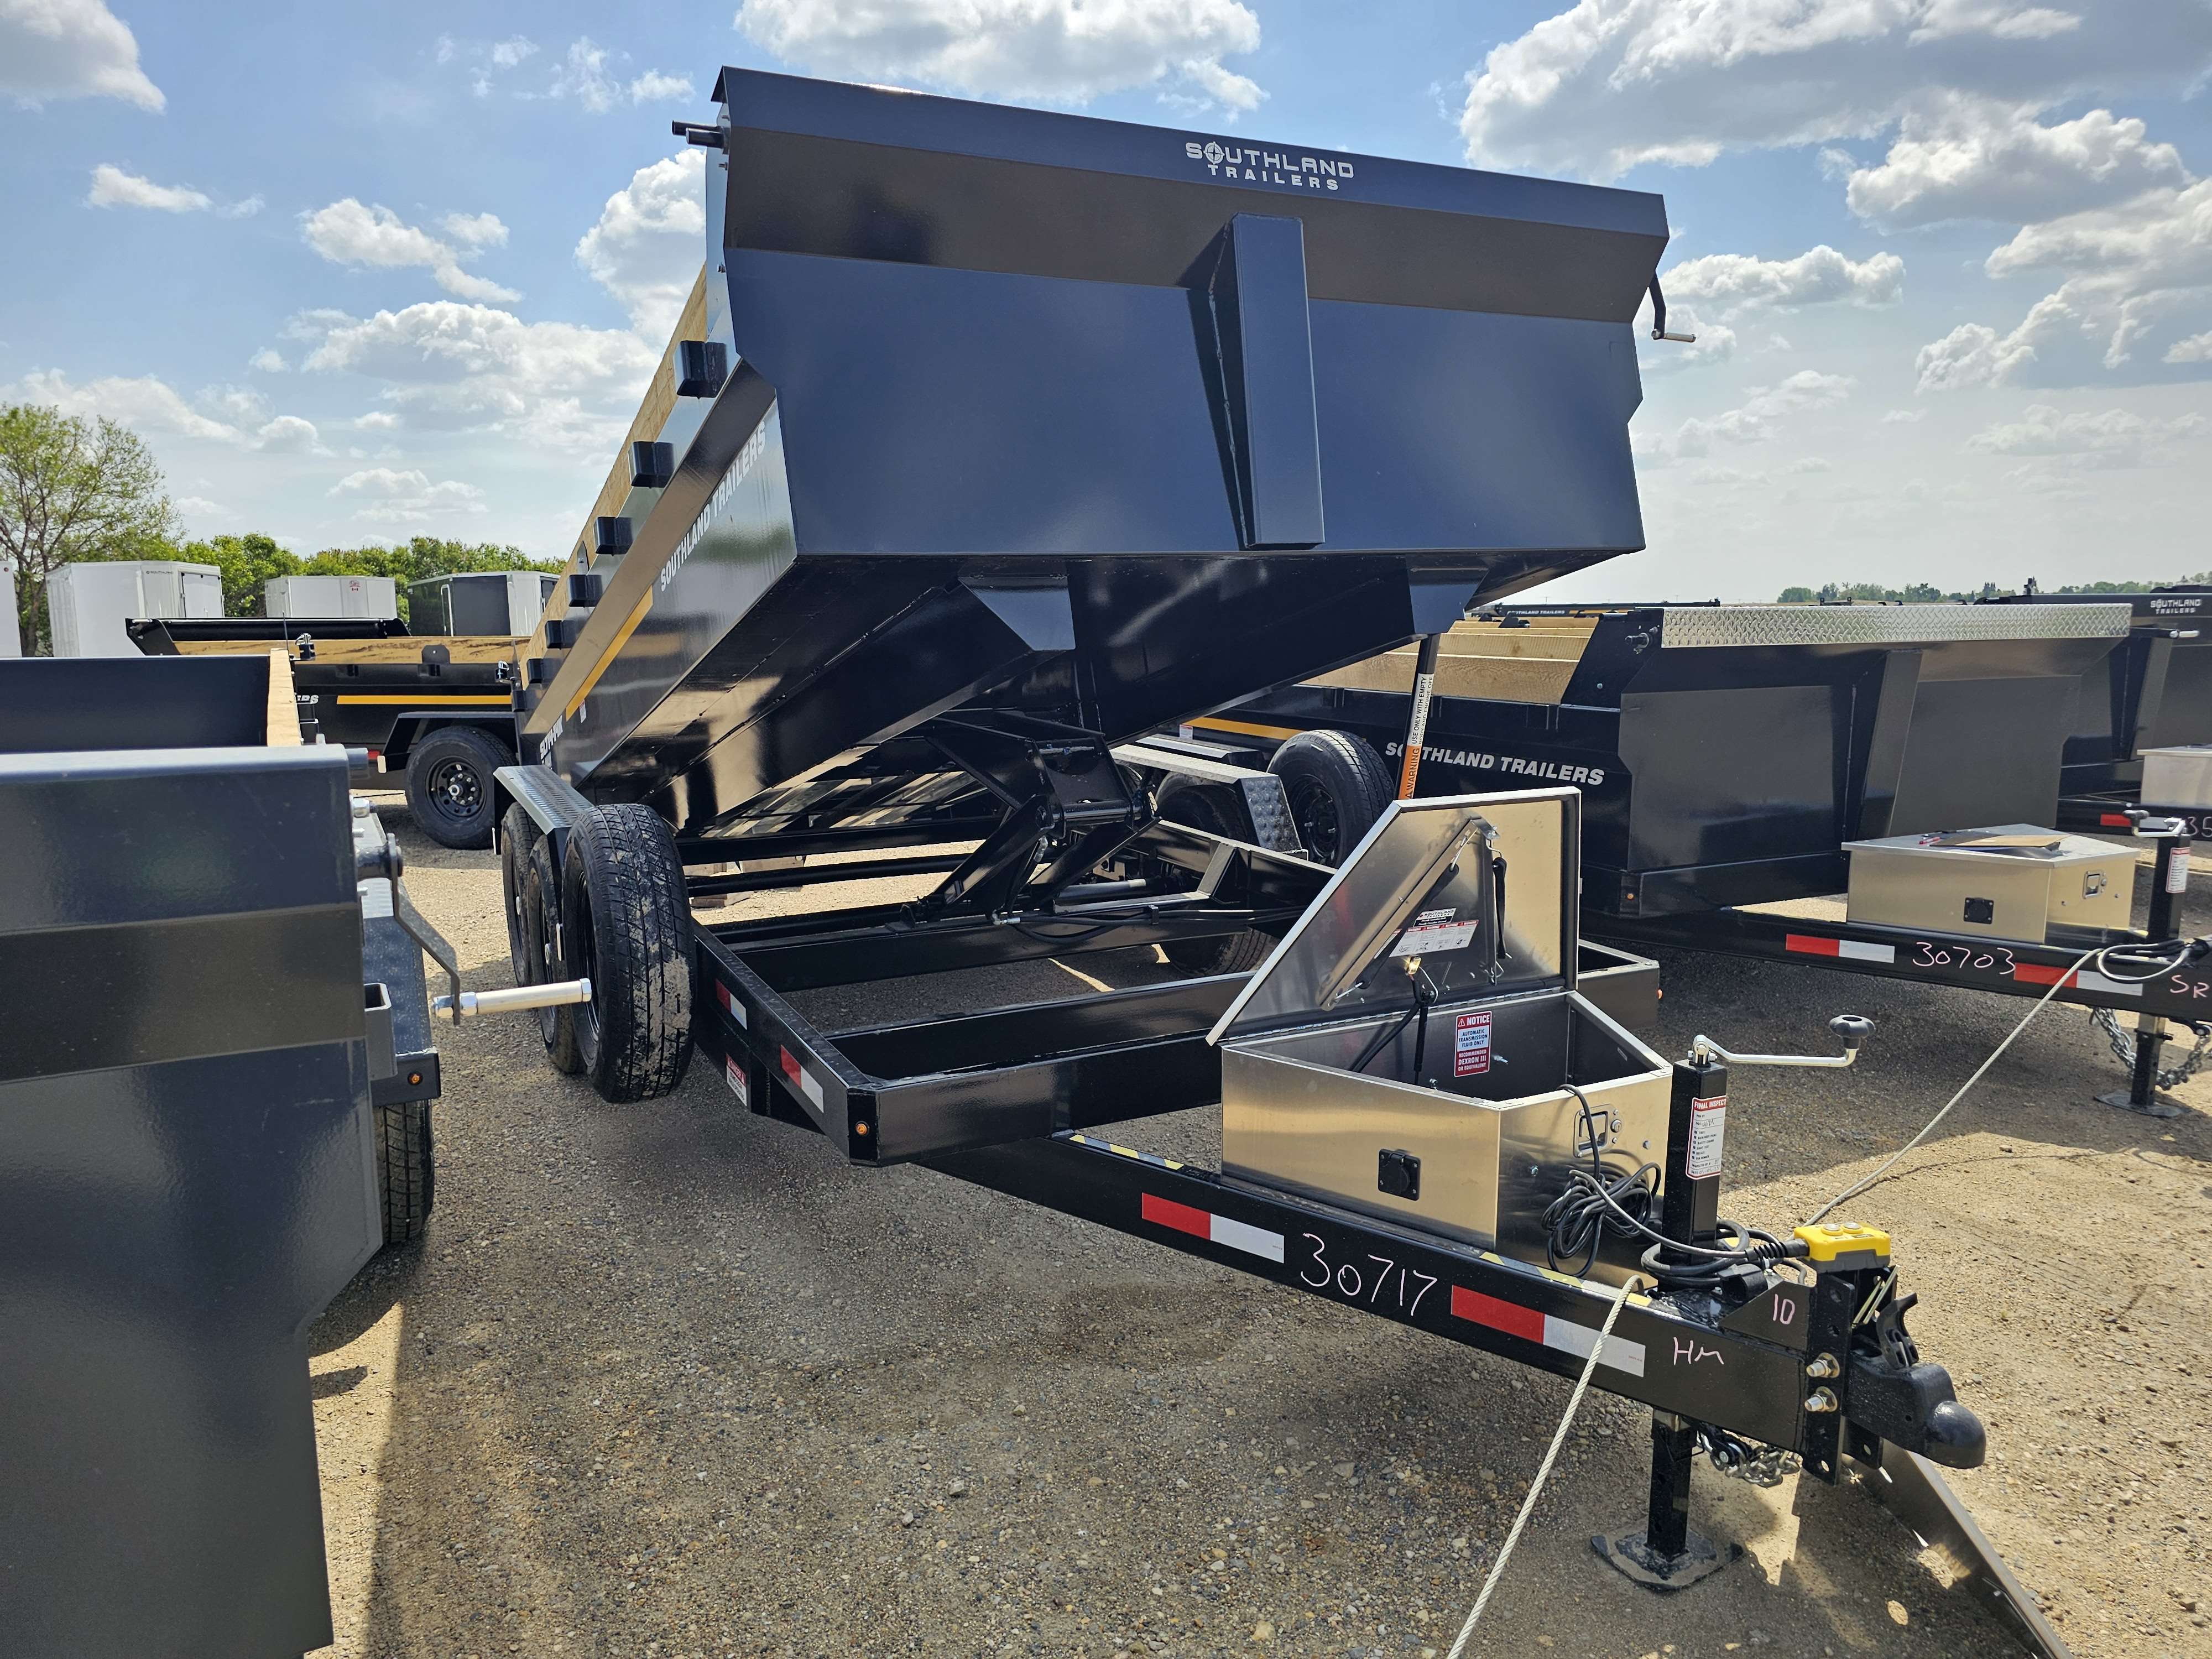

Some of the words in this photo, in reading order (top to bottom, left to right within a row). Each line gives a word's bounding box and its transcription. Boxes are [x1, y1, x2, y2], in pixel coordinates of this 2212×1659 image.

[1185, 142, 1354, 178] SOUTHLAND
[1208, 164, 1338, 191] TRAILERS
[660, 503, 711, 592] SOUTHLAND
[712, 421, 766, 518] TRAILERS
[2150, 599, 2201, 608] SOUTHLAND
[1419, 677, 1427, 697] EMPTY
[1386, 742, 1494, 769] STHLAND
[1501, 756, 1604, 785] TRAILERS
[1406, 748, 1420, 790] WARNING
[1913, 942, 2016, 974] 30703
[1467, 1014, 1490, 1026] NOTICE
[1459, 1034, 1488, 1042] TRANSMISSION
[1458, 1056, 1479, 1066] DEXRON
[1459, 1049, 1486, 1058] RECOMMENDED
[1694, 1101, 1708, 1110] FINAL
[1301, 1233, 1438, 1317] 30717
